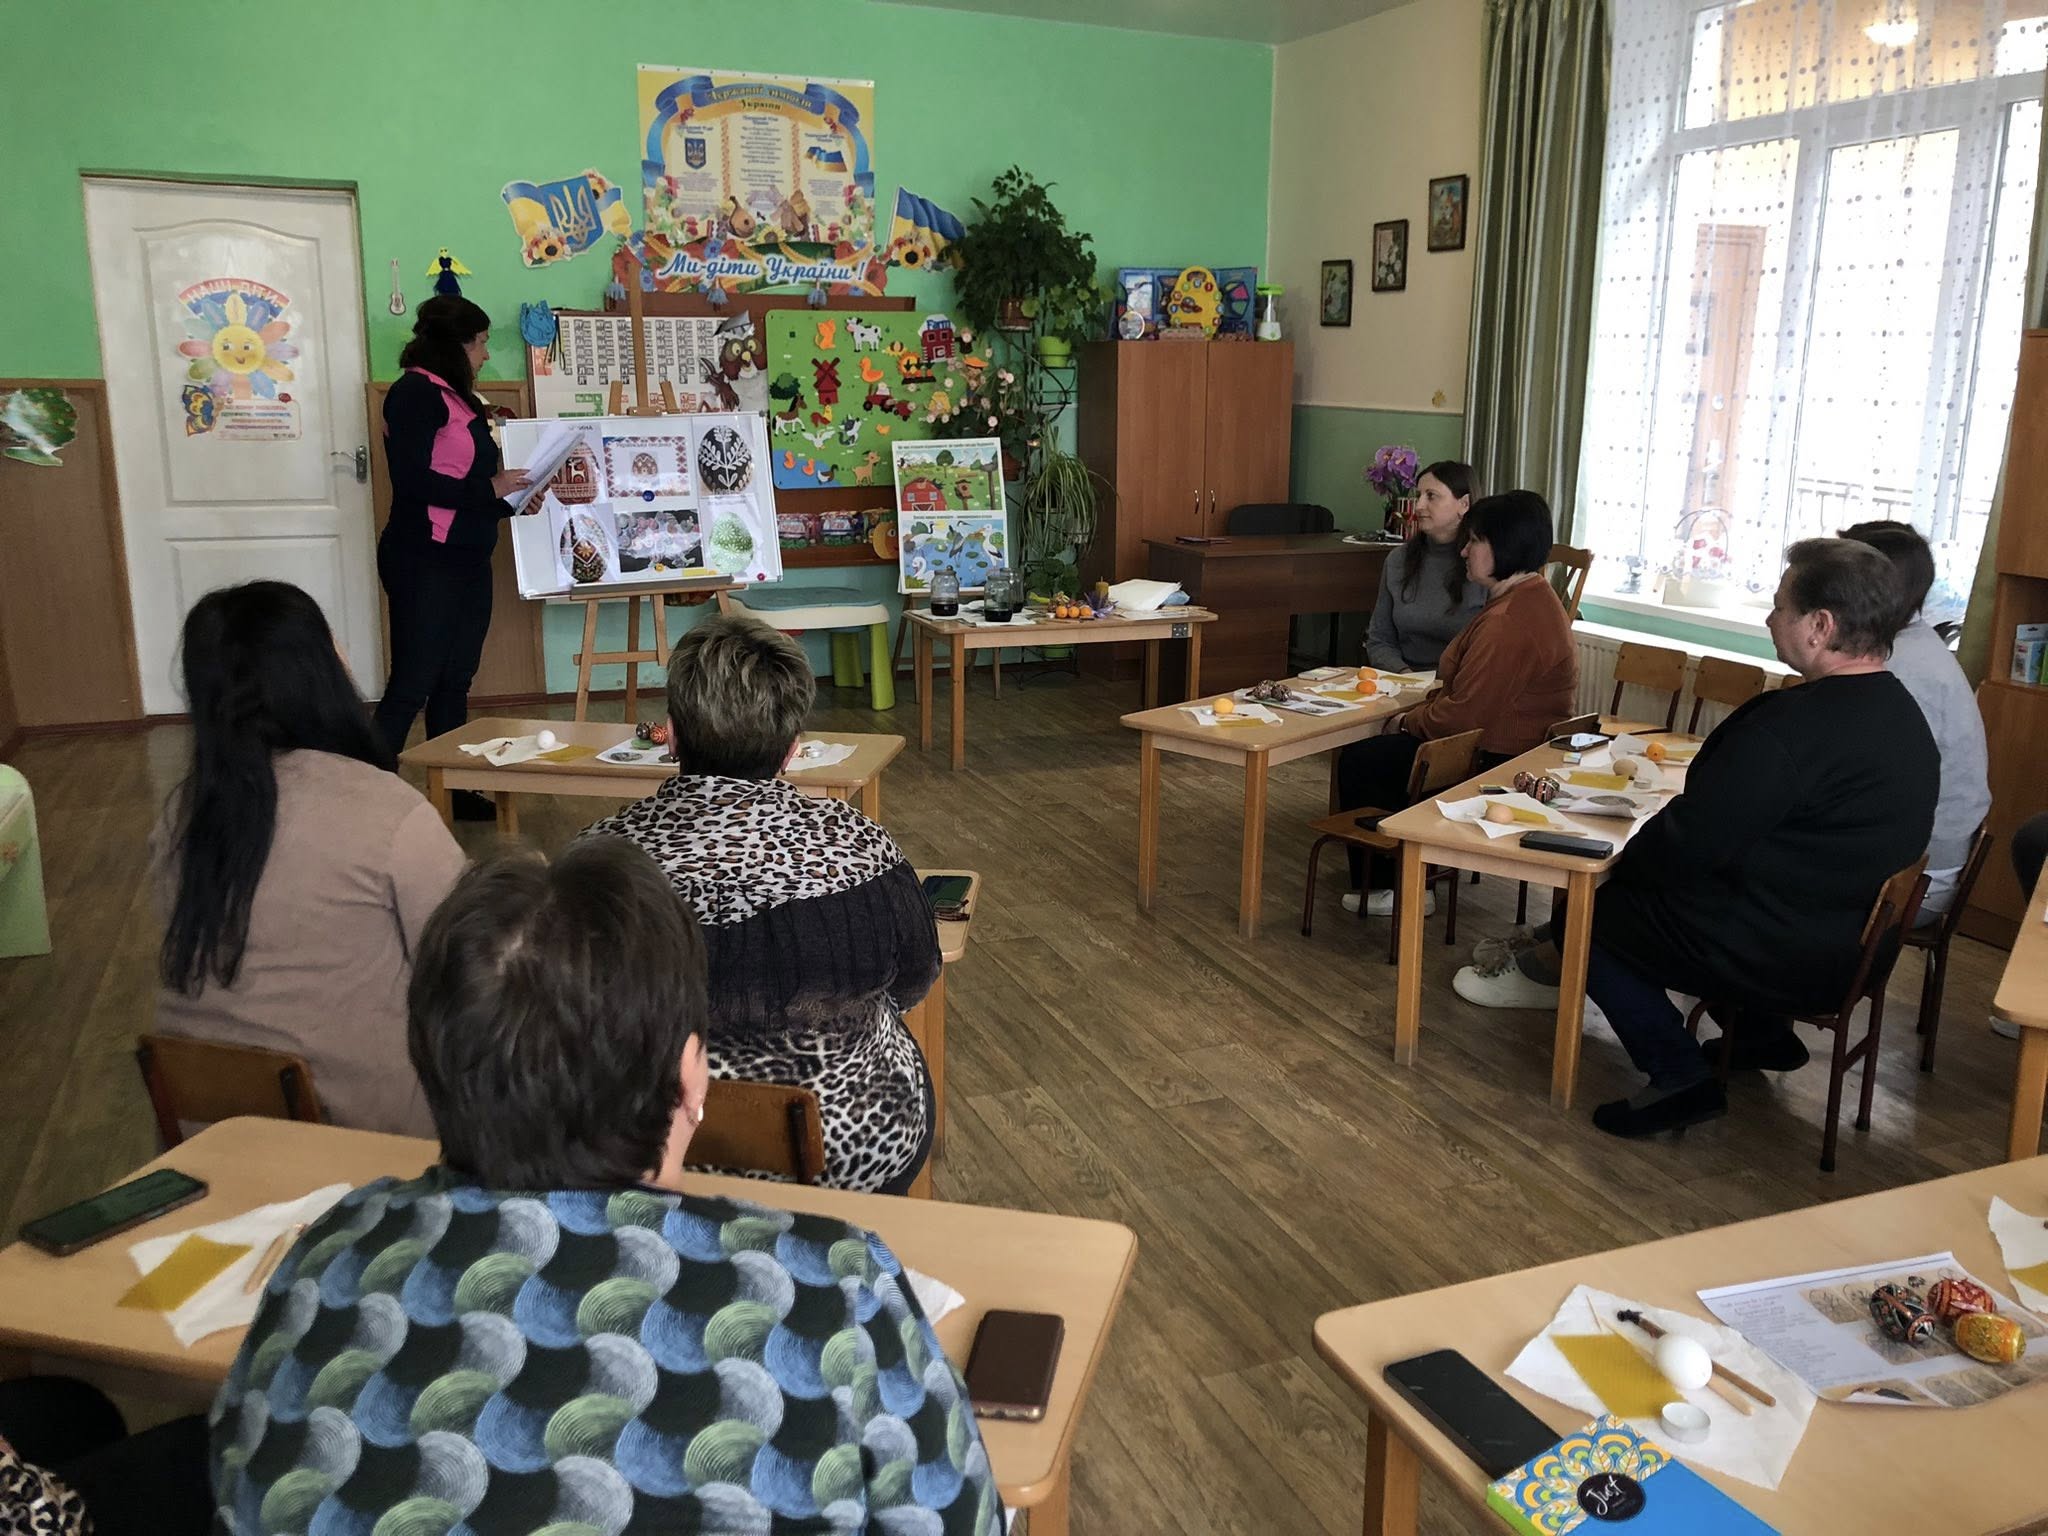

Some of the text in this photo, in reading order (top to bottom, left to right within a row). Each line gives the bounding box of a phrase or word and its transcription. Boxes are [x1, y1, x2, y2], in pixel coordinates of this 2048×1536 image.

[658, 253, 759, 280] Ми-діти
[766, 256, 852, 283] України
[926, 319, 951, 330] Farm
